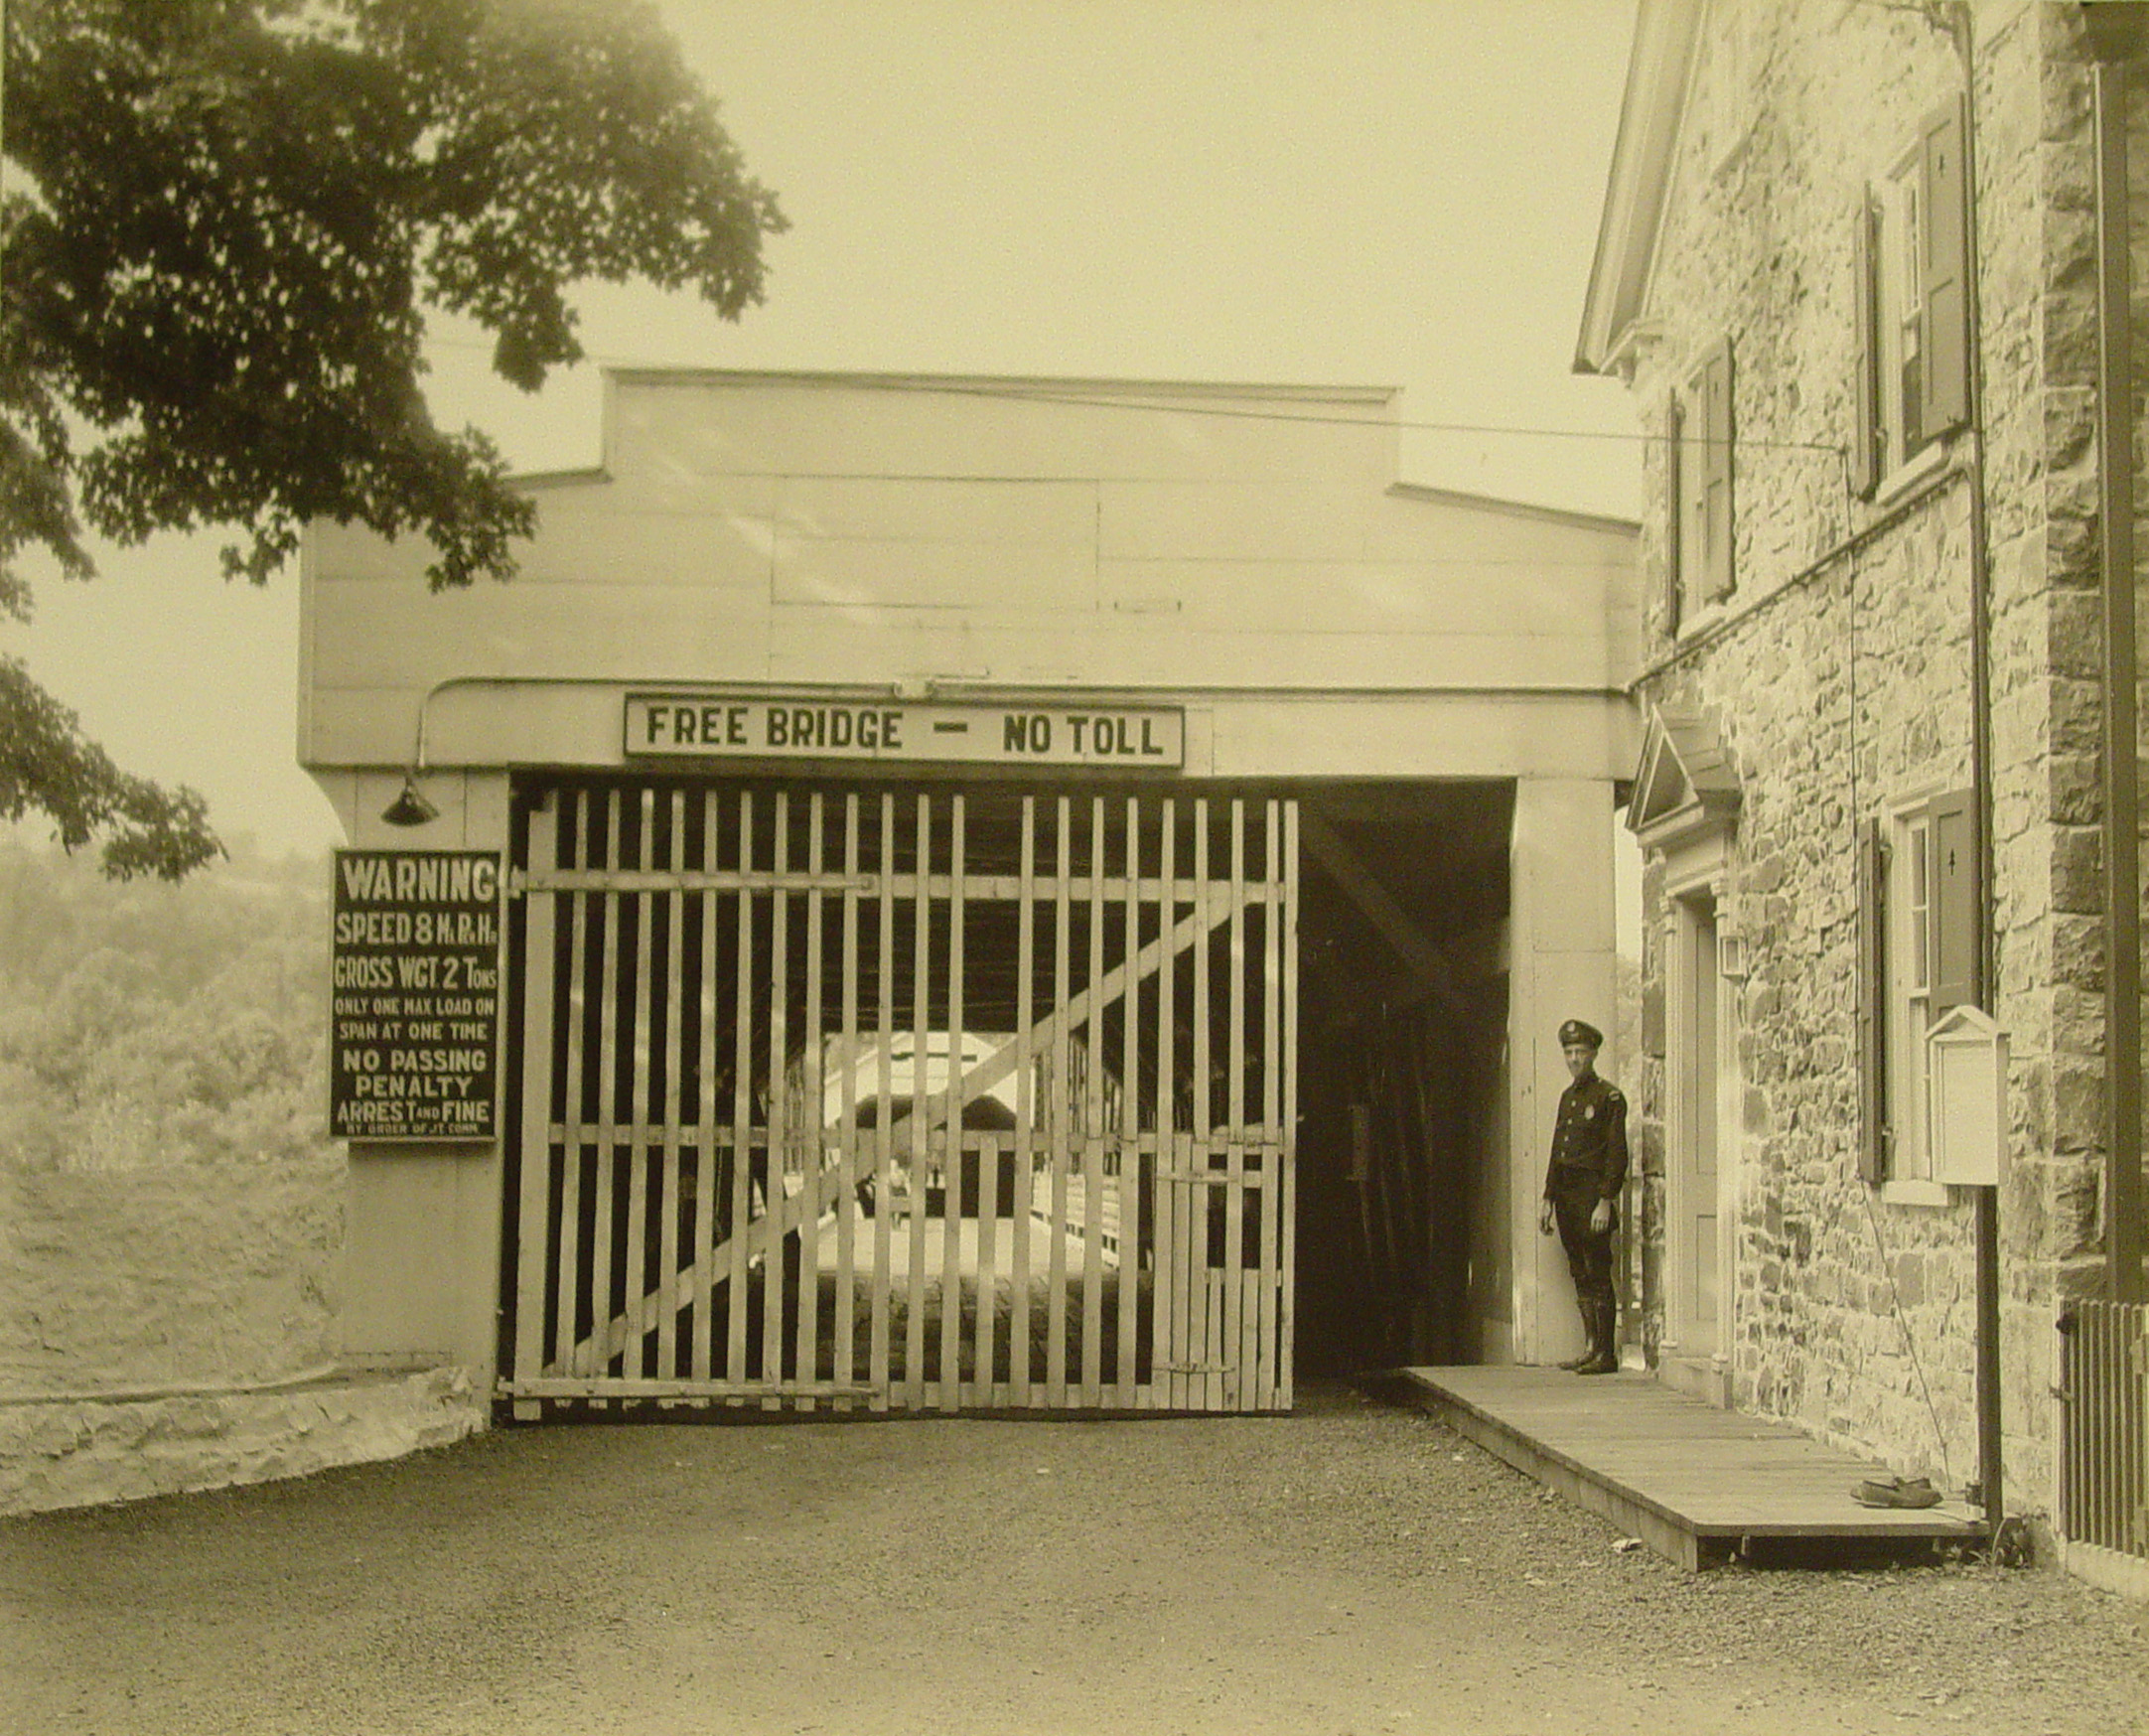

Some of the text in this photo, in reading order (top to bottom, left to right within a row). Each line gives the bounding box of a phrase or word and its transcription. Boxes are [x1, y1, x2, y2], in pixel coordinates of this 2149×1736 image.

[646, 706, 749, 747] FREE
[766, 708, 903, 749] BRIDGE
[1003, 715, 1052, 754] NO
[1067, 715, 1163, 756] TOLL
[342, 858, 496, 902] WARNING
[336, 912, 412, 944] SPEED
[414, 912, 433, 944] 8
[335, 955, 394, 988] GROSS
[442, 956, 460, 989] 2
[335, 997, 368, 1015] ONLY
[372, 997, 400, 1015] ONE
[435, 997, 472, 1015] LOAD
[476, 997, 495, 1016] ON
[340, 1022, 488, 1041] SPAN AT ONE TIME
[343, 1049, 487, 1073] NO PASSING
[356, 1075, 474, 1098] PENALTY
[337, 1100, 490, 1123] ARREST AND FINE
